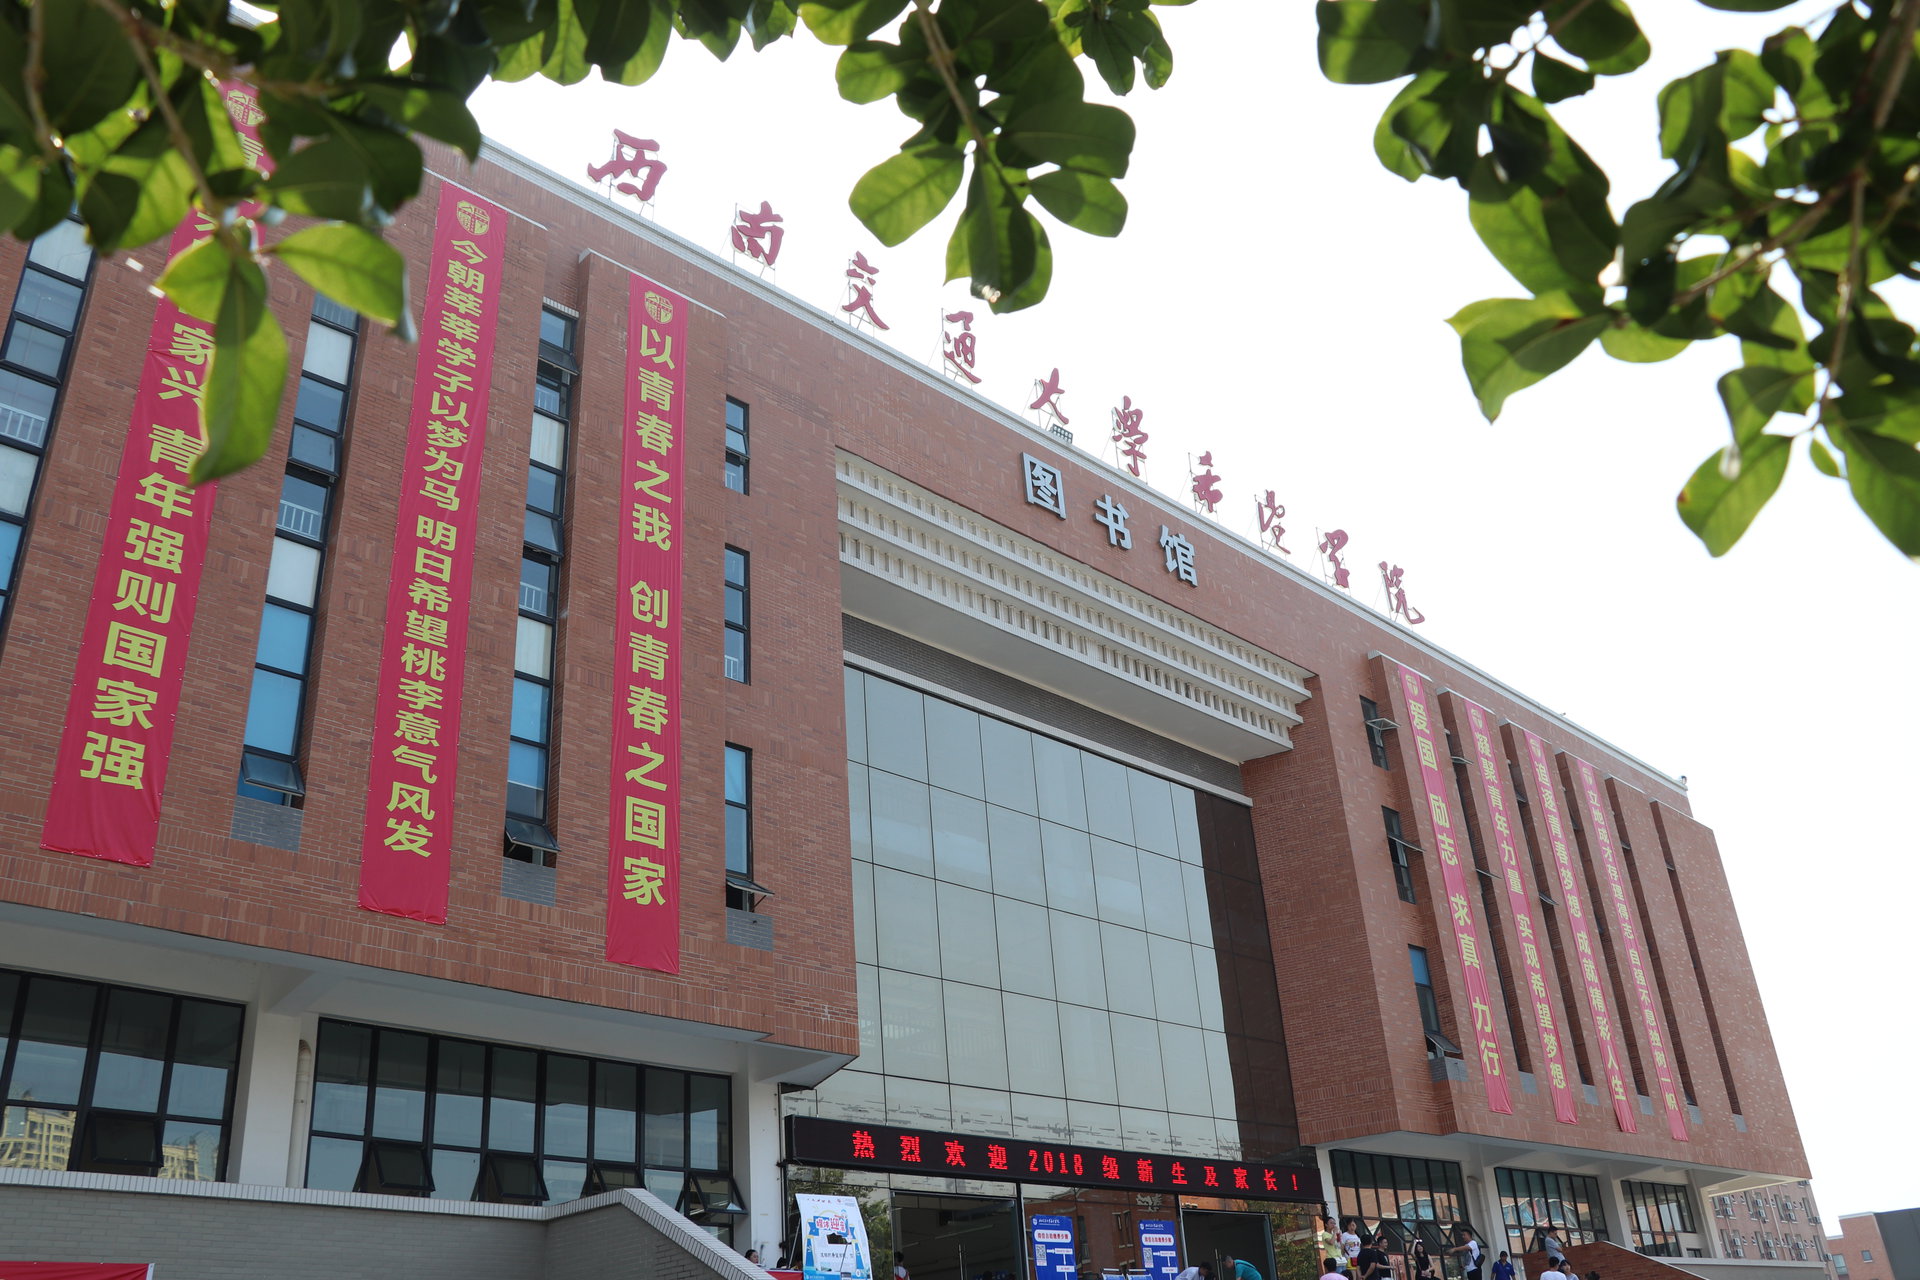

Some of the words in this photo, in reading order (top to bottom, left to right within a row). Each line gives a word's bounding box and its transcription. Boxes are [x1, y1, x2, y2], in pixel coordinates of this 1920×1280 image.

[419, 239, 488, 512] 今朝莘莘学子以梦为马
[632, 324, 675, 551] 以青春之我
[1022, 452, 1198, 587] 图书馆
[80, 423, 206, 790] 青年强则国家强
[384, 514, 457, 857] 明日希望桃李意气风发
[623, 580, 669, 906] 创青春之国家
[1408, 699, 1438, 771] 爱国
[1430, 793, 1458, 866] 励志
[1451, 893, 1480, 968] 求真
[1472, 997, 1500, 1076] 力行
[1475, 732, 1525, 894] 凝聚青年力量
[1517, 914, 1566, 1089] 实现希望梦想
[1535, 762, 1581, 918] 追逐青春梦想
[1577, 931, 1626, 1101] 成就精彩人生
